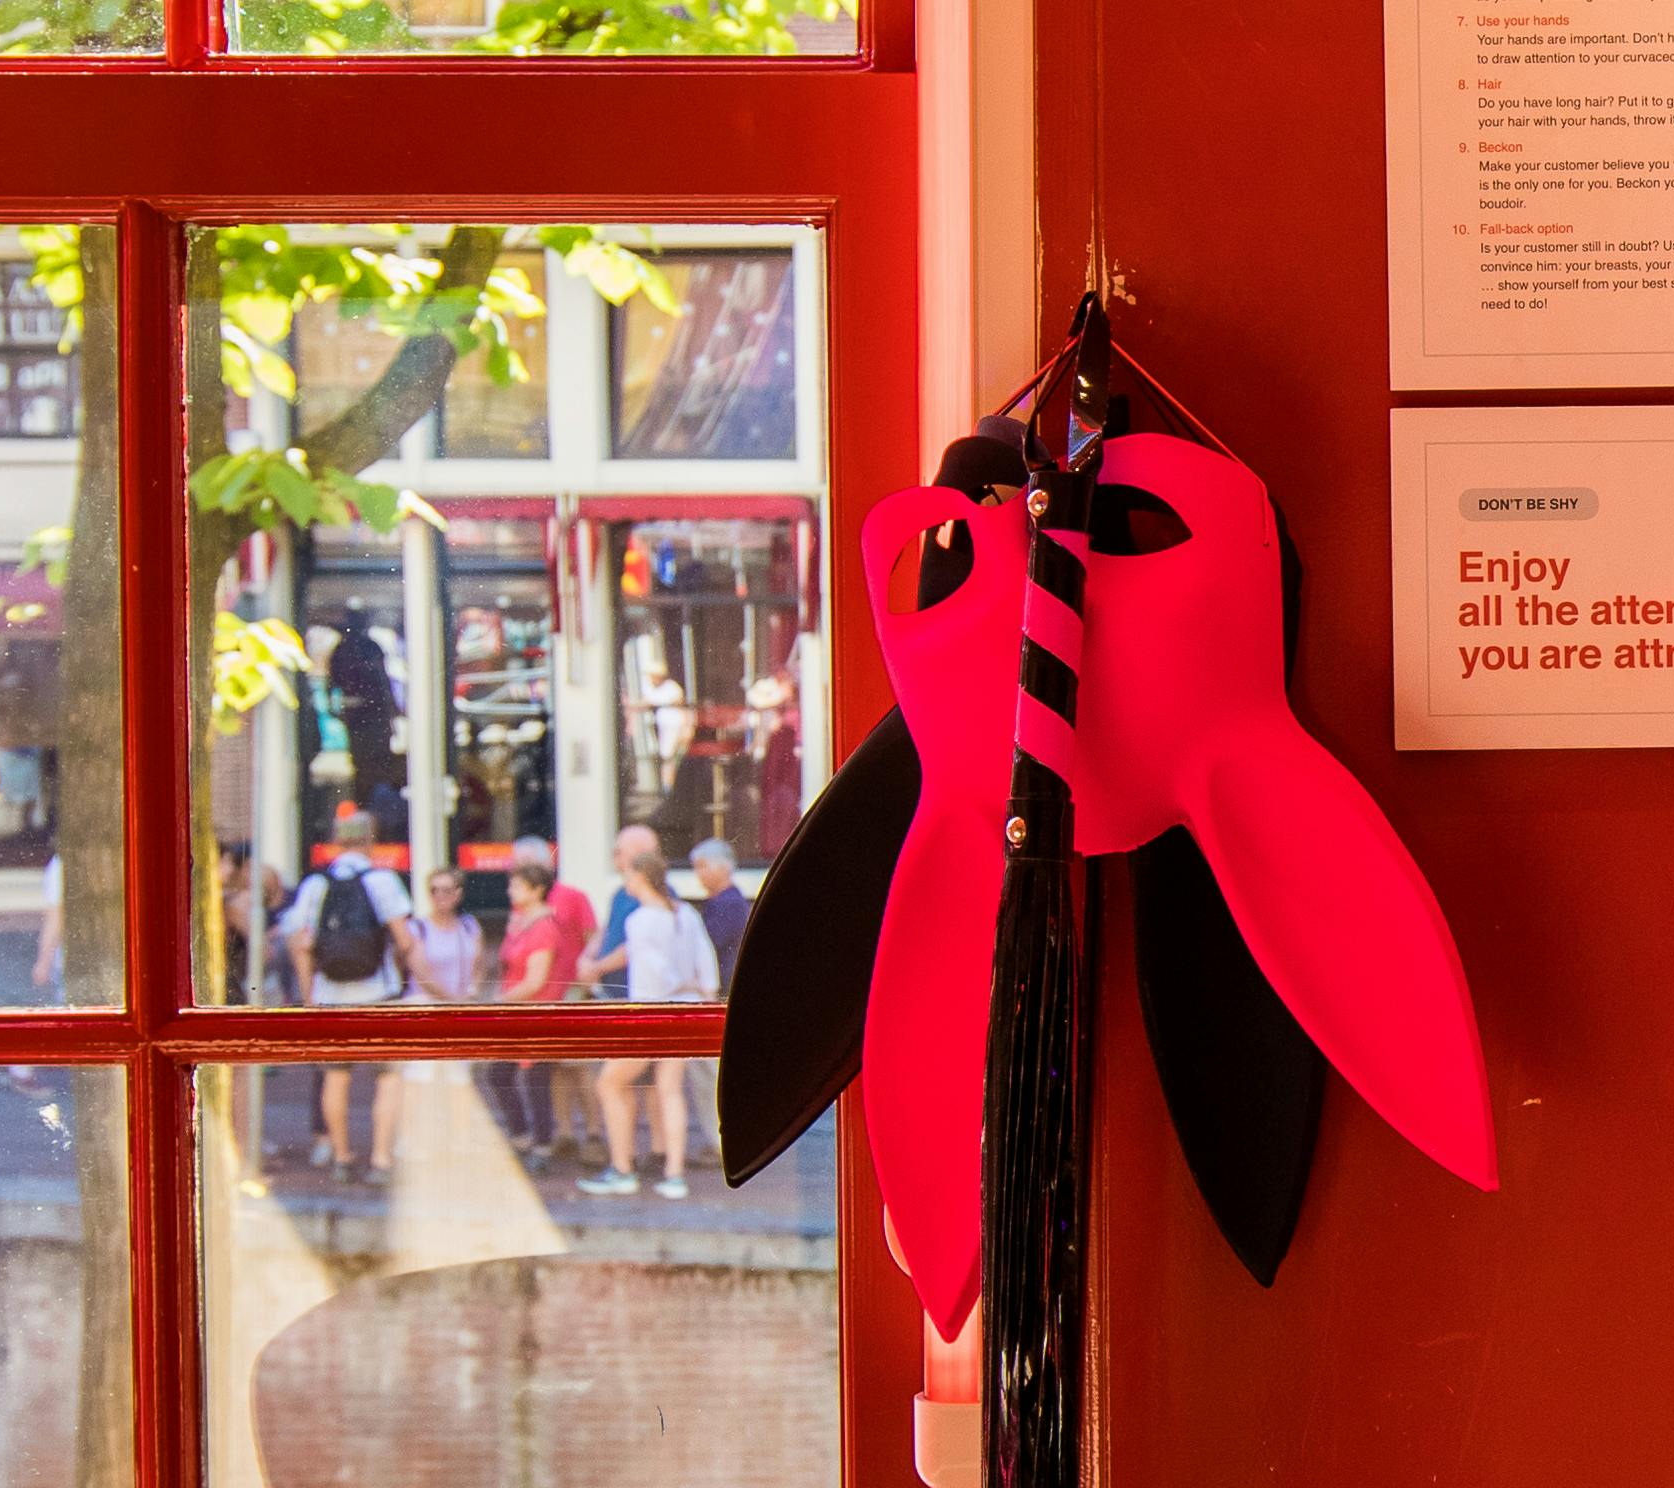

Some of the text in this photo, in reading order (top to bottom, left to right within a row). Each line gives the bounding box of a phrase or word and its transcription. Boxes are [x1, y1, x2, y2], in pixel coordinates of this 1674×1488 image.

[1456, 14, 1570, 30] 7. Use your hands
[1476, 34, 1504, 46] Your
[1507, 33, 1544, 46] hands
[1546, 35, 1567, 45] are
[1569, 33, 1629, 47] important.
[1476, 54, 1489, 65] to
[1491, 52, 1521, 65] draw
[1524, 52, 1576, 64] attention
[1578, 53, 1591, 64] to
[1593, 54, 1620, 66] your
[1457, 78, 1503, 91] 8. Hair
[1458, 141, 1523, 154] 9. Beckon
[1479, 197, 1527, 210] boudoir.
[1452, 222, 1574, 237] 10. Fall-back option
[1481, 297, 1548, 310] need to do!
[1526, 498, 1547, 511] BE
[1549, 497, 1579, 510] SHY
[1459, 550, 1571, 592] Enjoy
[1458, 594, 1502, 628] all
[1515, 594, 1579, 626] the
[1458, 645, 1529, 680] you
[1539, 644, 1602, 670] are
